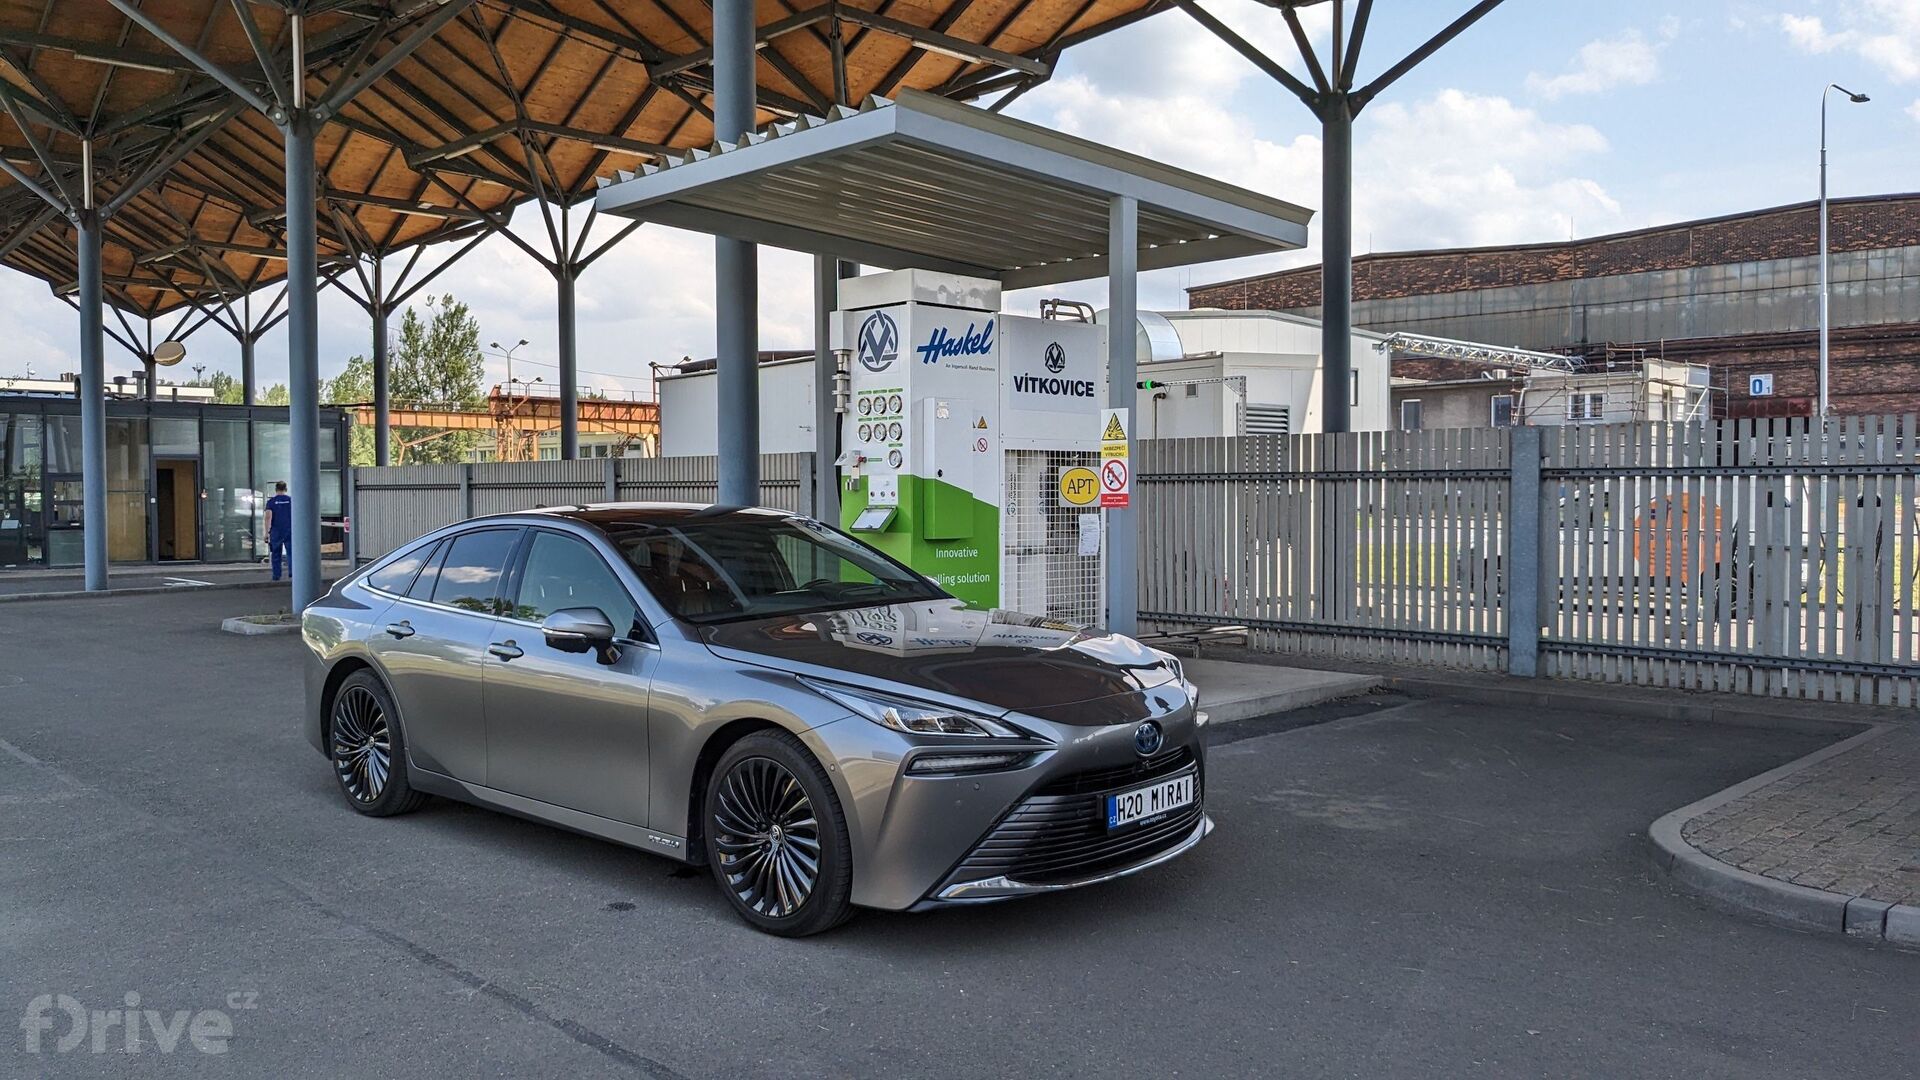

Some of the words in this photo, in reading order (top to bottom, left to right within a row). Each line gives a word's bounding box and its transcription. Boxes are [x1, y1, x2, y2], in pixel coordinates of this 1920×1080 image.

[916, 318, 994, 364] Haskel
[1013, 373, 1095, 397] VÍTKOVICE
[1066, 478, 1095, 495] APT
[935, 546, 978, 558] Innovative
[957, 571, 990, 584] solution
